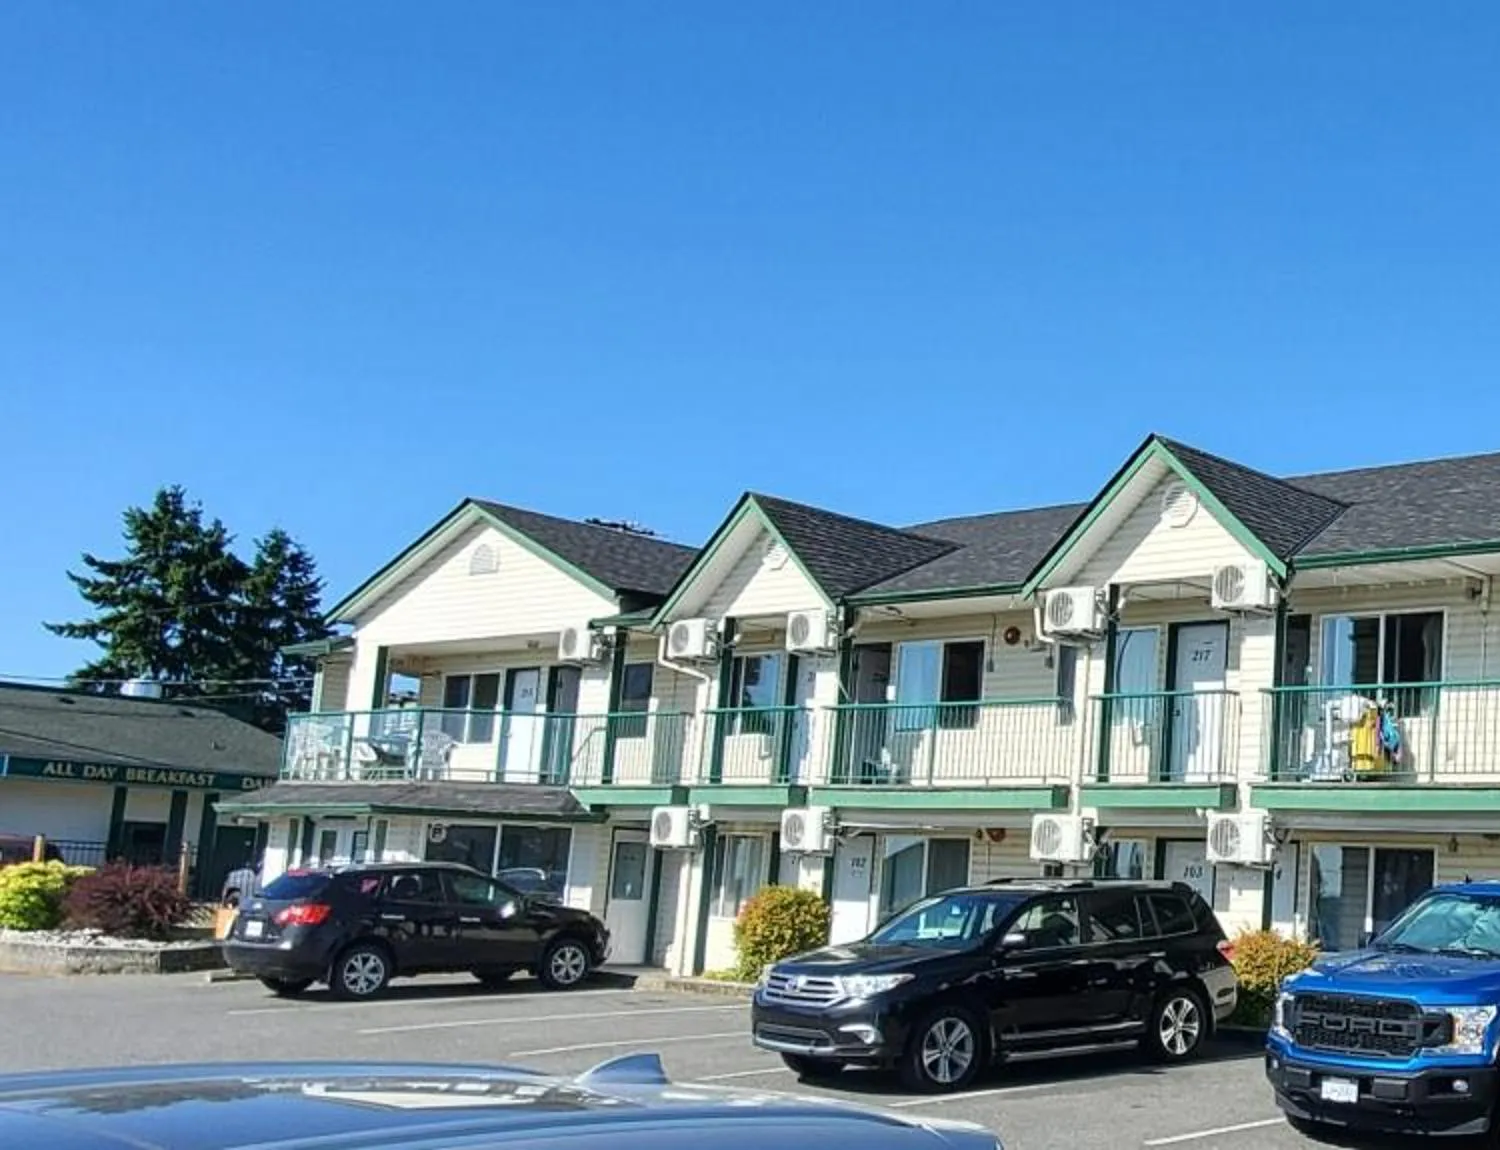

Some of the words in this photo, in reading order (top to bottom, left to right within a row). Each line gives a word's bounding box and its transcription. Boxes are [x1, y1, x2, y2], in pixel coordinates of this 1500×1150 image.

[1191, 649, 1211, 662] 217
[43, 761, 74, 777] ALL
[82, 765, 117, 779] DAY
[125, 767, 216, 787] BREAKFAST
[1299, 1011, 1406, 1036] FORD
